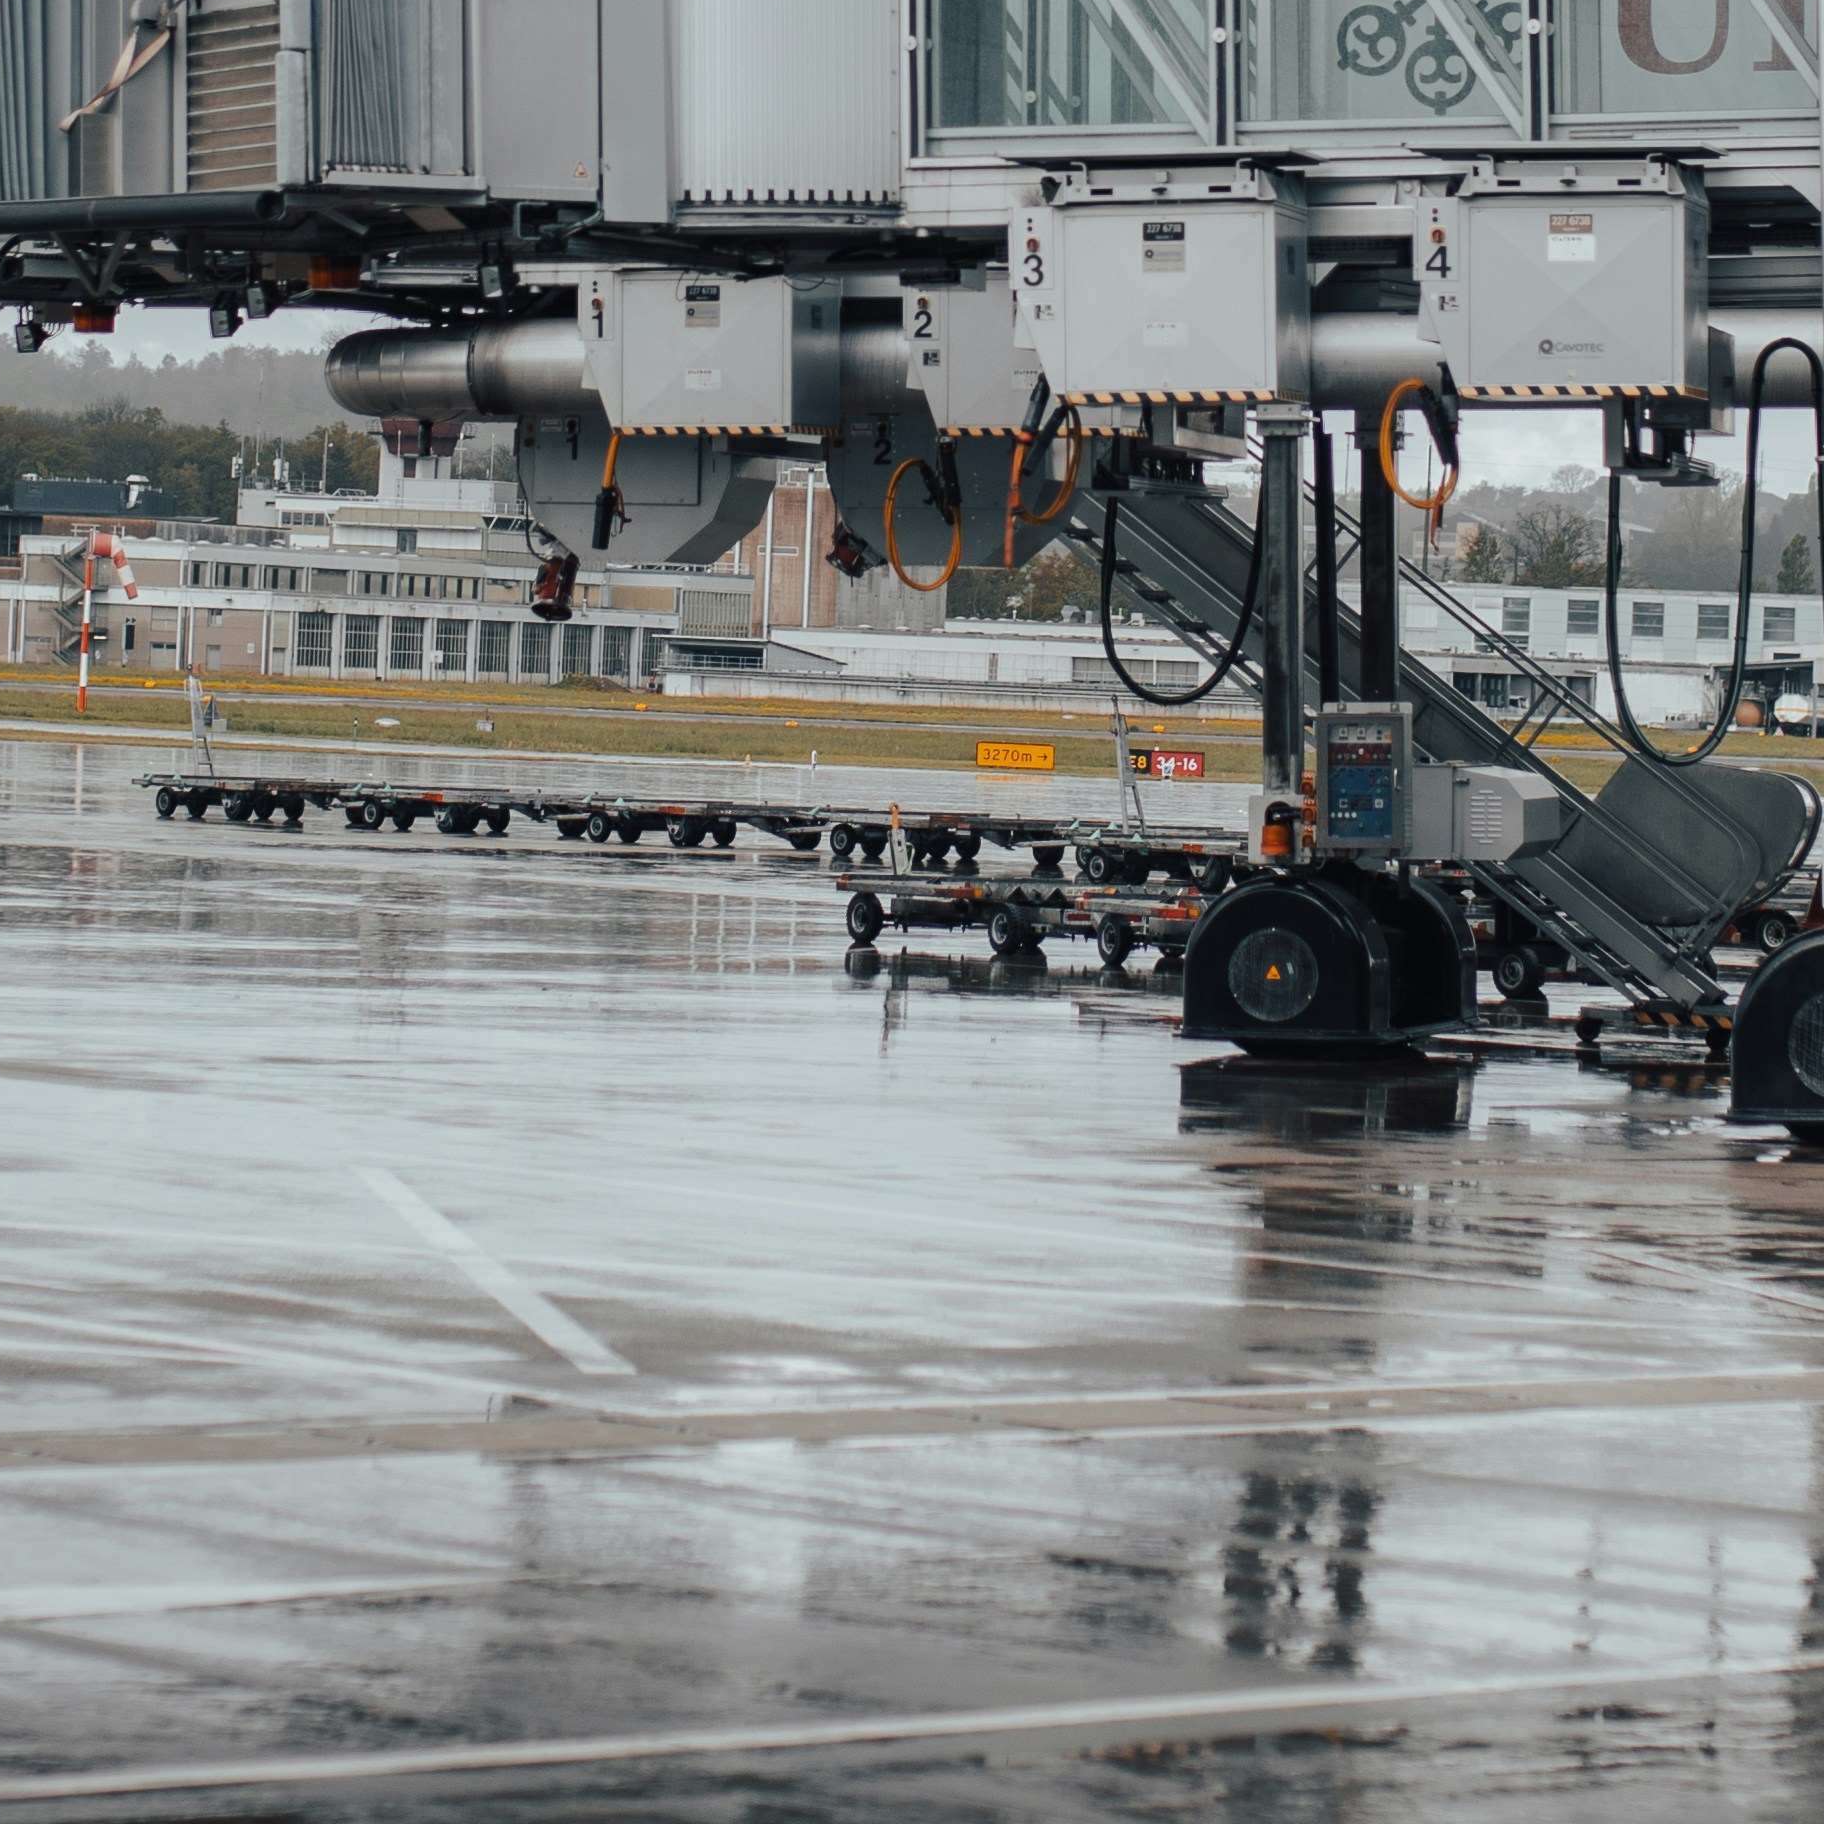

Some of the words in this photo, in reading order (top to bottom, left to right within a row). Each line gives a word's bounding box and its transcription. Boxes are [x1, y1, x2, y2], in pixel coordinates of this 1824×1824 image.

[1023, 254, 1044, 286] 3
[1425, 245, 1452, 279] 4
[592, 311, 603, 338] 1
[914, 310, 932, 338] 2
[566, 433, 578, 461] 1
[873, 438, 892, 465] 2
[983, 748, 1032, 762] 3270m
[1156, 756, 1198, 771] 34-16
